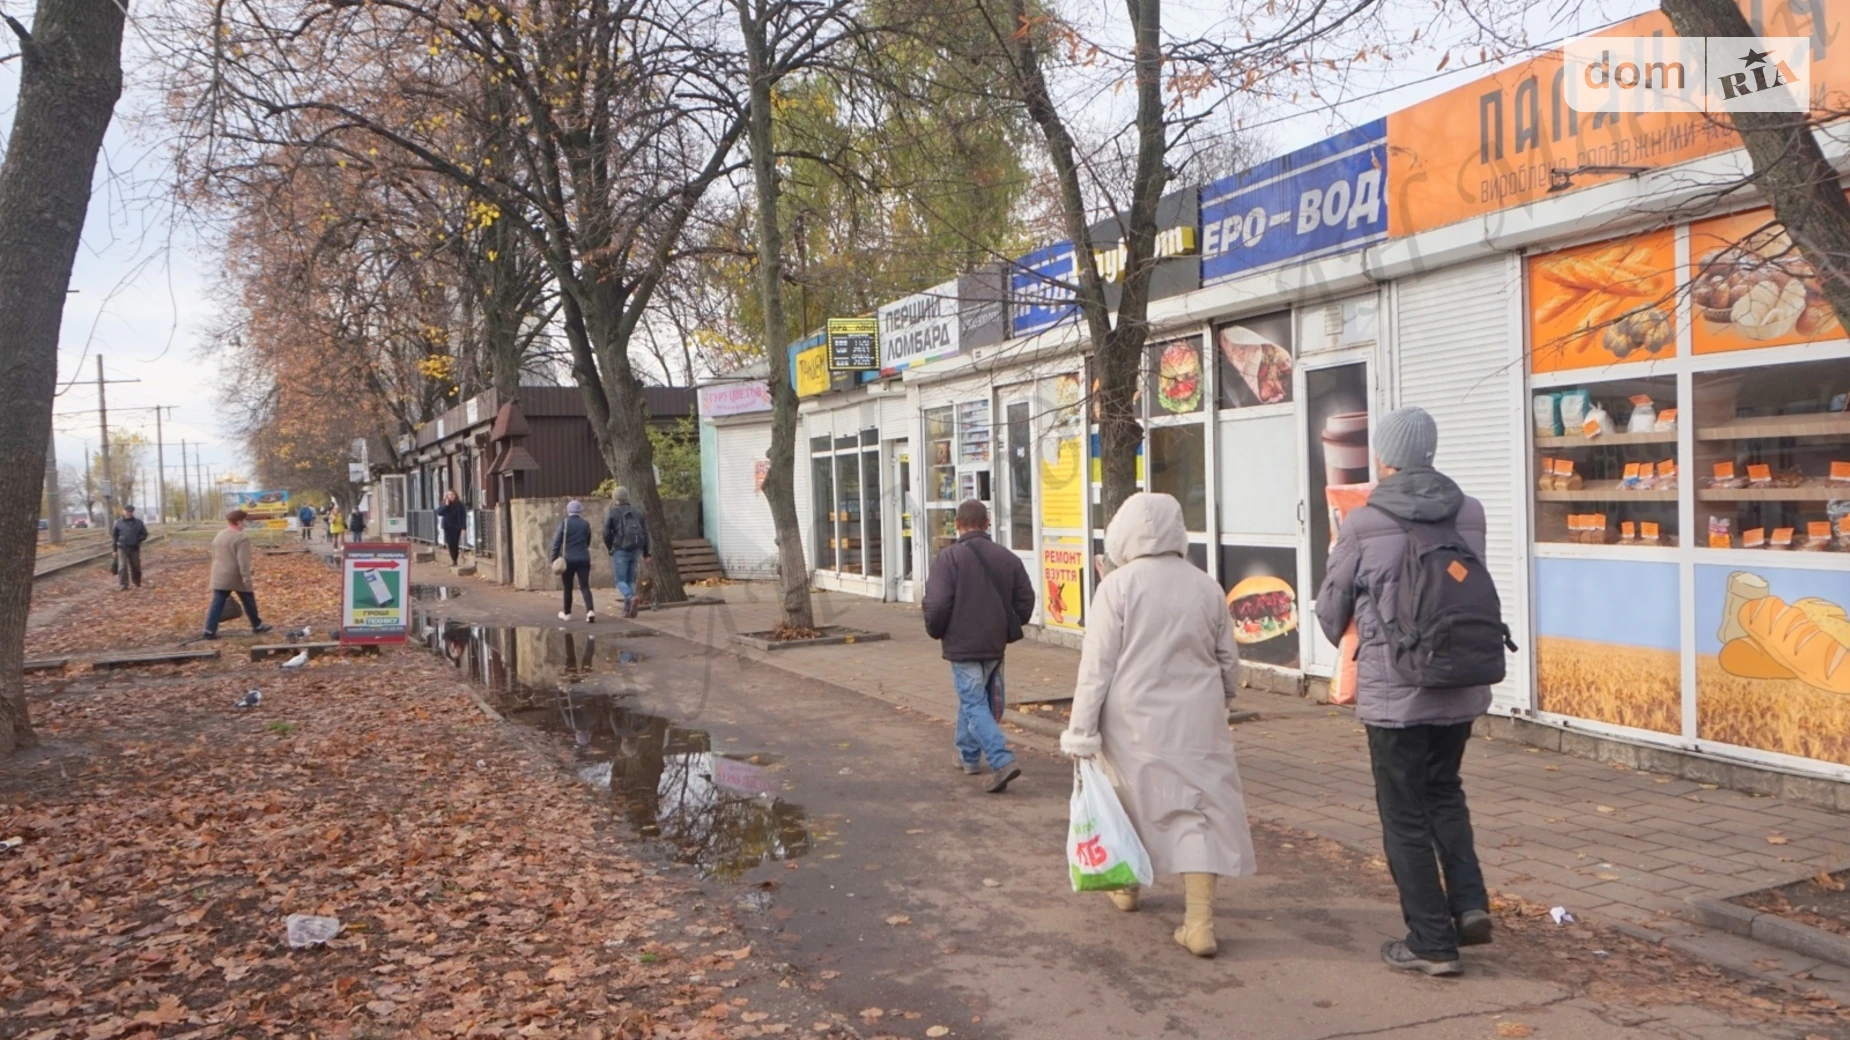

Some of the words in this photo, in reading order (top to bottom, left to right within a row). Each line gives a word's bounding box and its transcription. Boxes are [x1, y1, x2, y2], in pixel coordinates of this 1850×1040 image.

[1201, 169, 1388, 259] ЕРО-ВОД
[885, 297, 942, 334] ПЕРШИЙ
[887, 322, 950, 362] ЛОМБАРД
[1044, 549, 1082, 566] РЕМОНТ
[1044, 567, 1078, 582] ВЗУТТЯ
